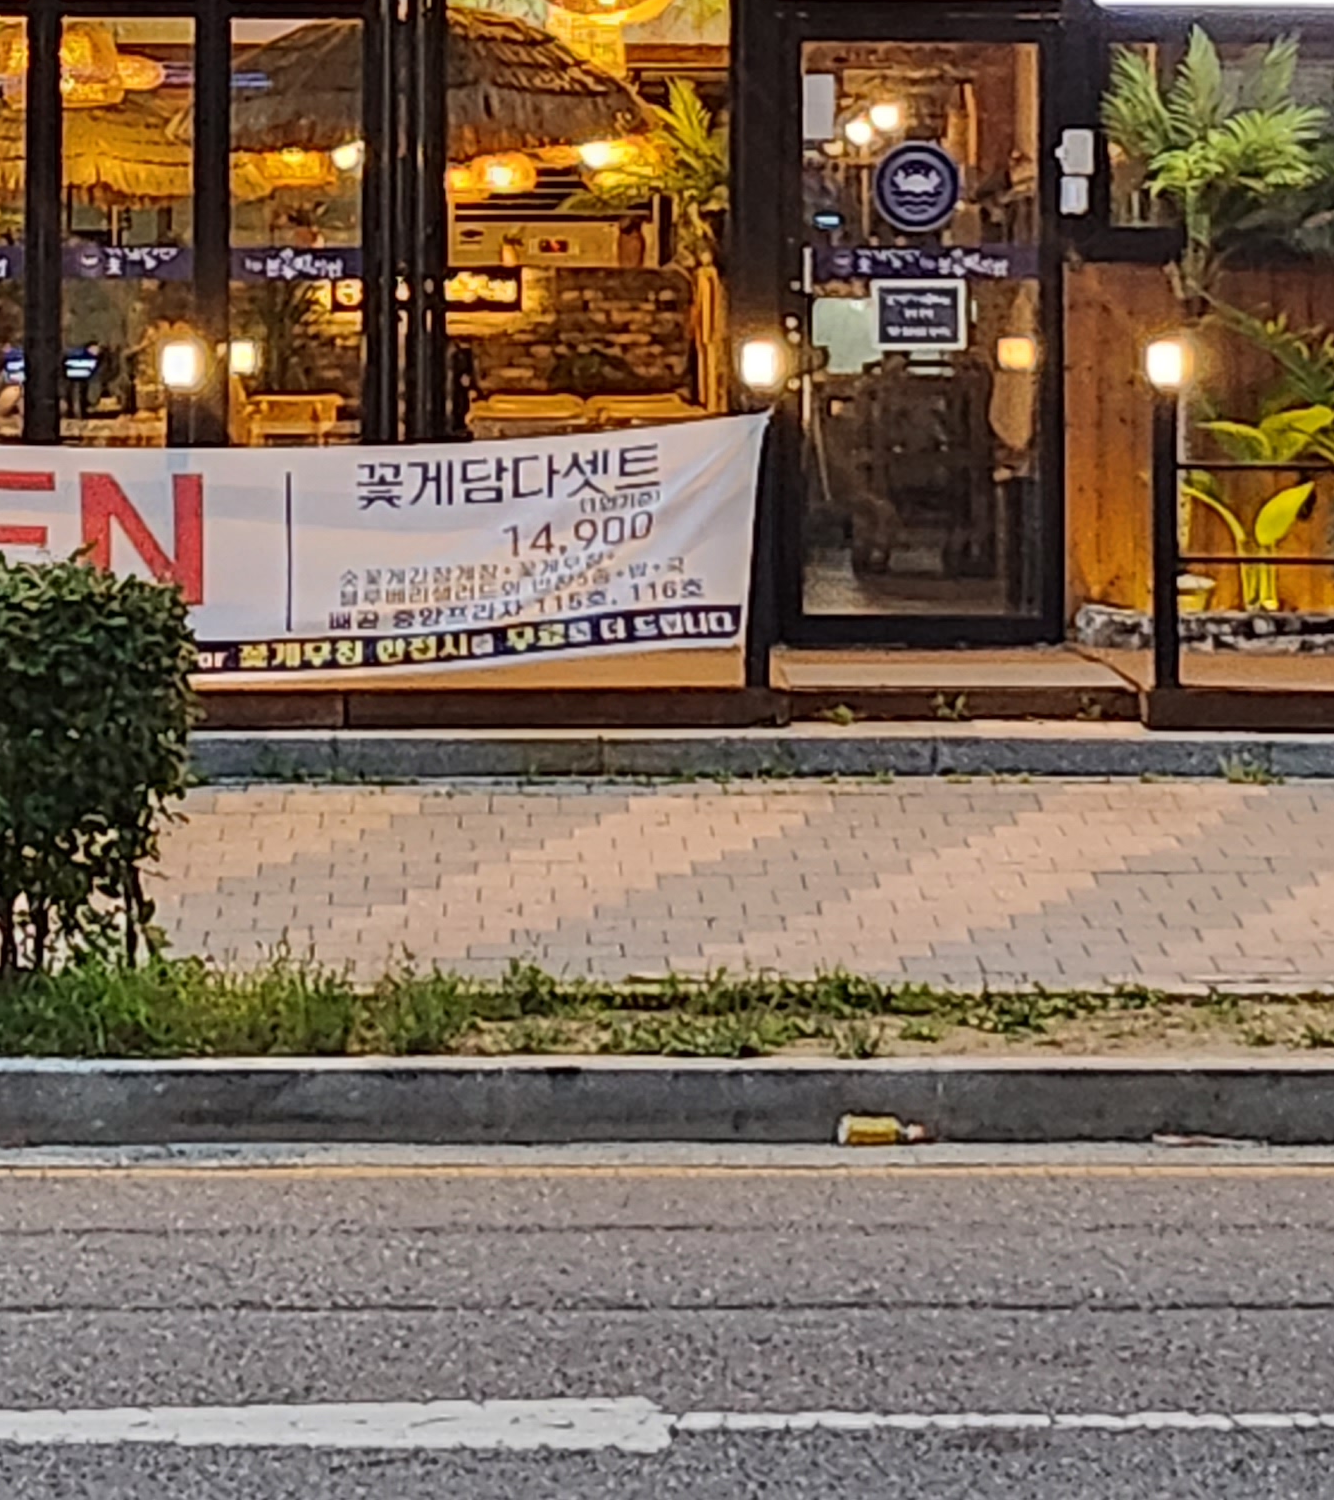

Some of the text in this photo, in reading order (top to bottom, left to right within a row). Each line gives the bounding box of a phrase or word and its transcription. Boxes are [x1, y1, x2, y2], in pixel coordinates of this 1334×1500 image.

[356, 443, 662, 511] 꽃게담다셋트
[501, 509, 654, 557] 14,900
[392, 600, 524, 630] 중앙프라자
